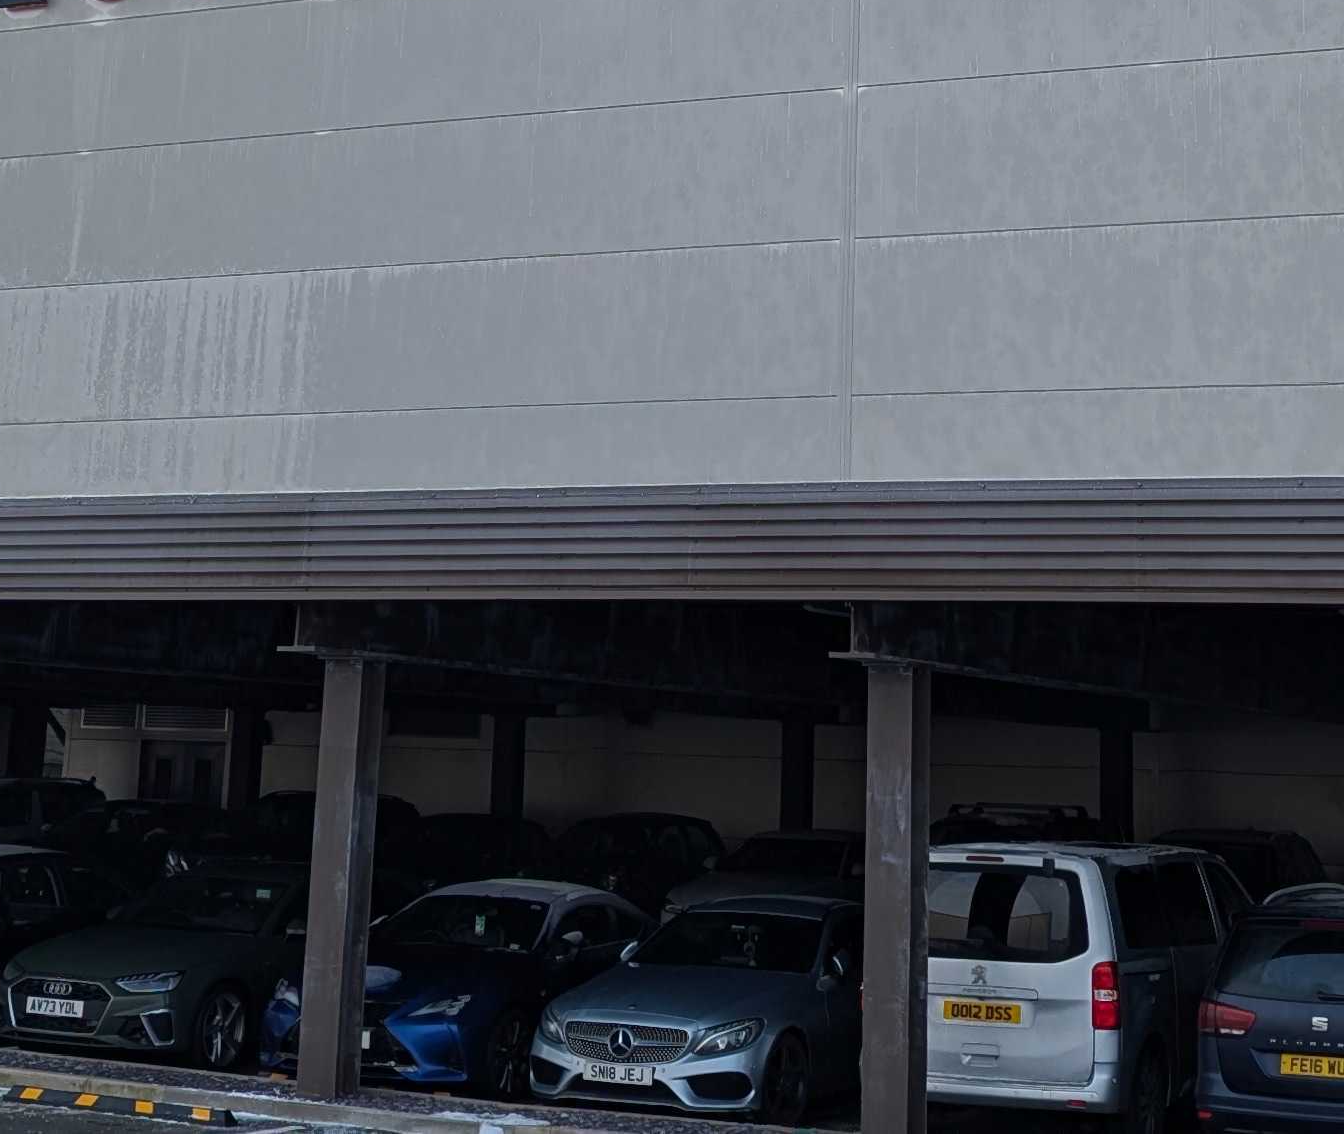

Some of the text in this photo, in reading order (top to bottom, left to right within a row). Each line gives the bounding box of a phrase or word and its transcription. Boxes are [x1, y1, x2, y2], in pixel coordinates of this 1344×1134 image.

[30, 998, 56, 1013] AV73
[590, 1065, 644, 1082] SN18 JEJ
[1290, 1057, 1323, 1074] FE16
